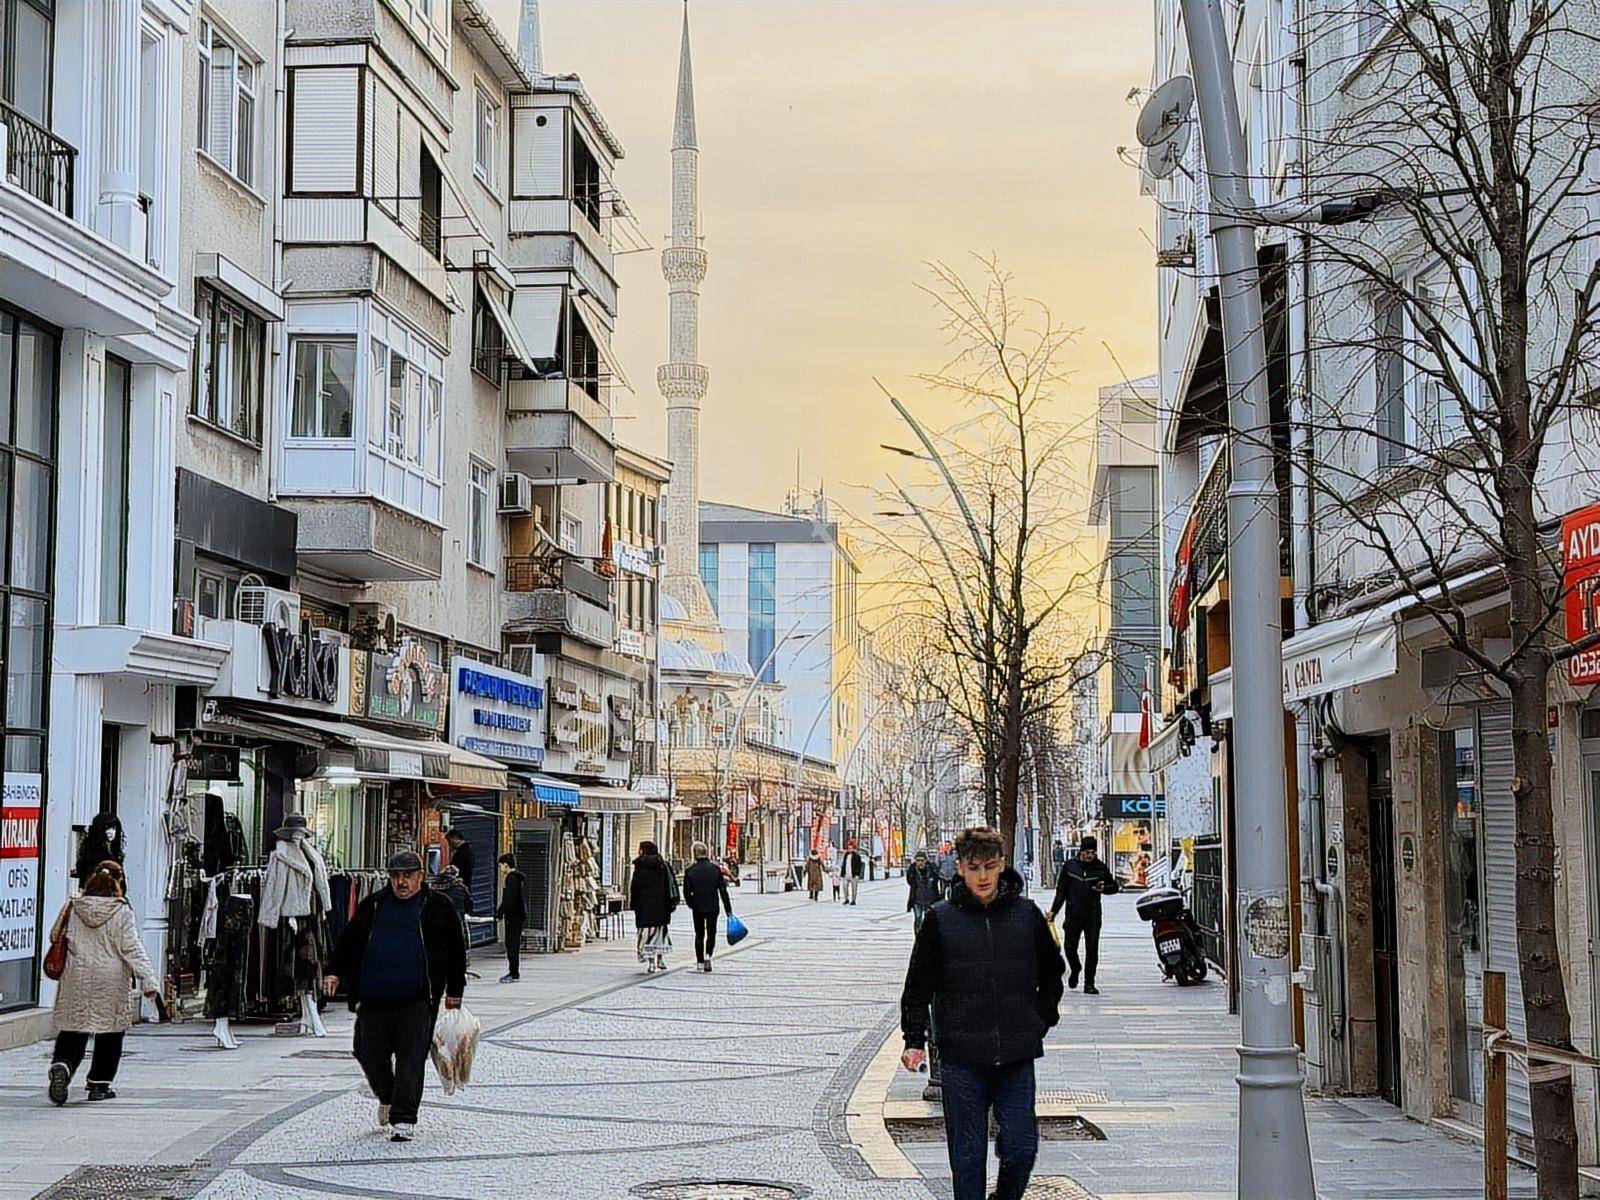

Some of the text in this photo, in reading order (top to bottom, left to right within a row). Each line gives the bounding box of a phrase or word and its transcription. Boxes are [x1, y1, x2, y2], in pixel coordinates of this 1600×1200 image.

[1295, 658, 1322, 696] ÇANTA
[1, 812, 38, 848] KİRALIK
[8, 864, 28, 888] OFİS
[0, 898, 35, 919] KATLARI
